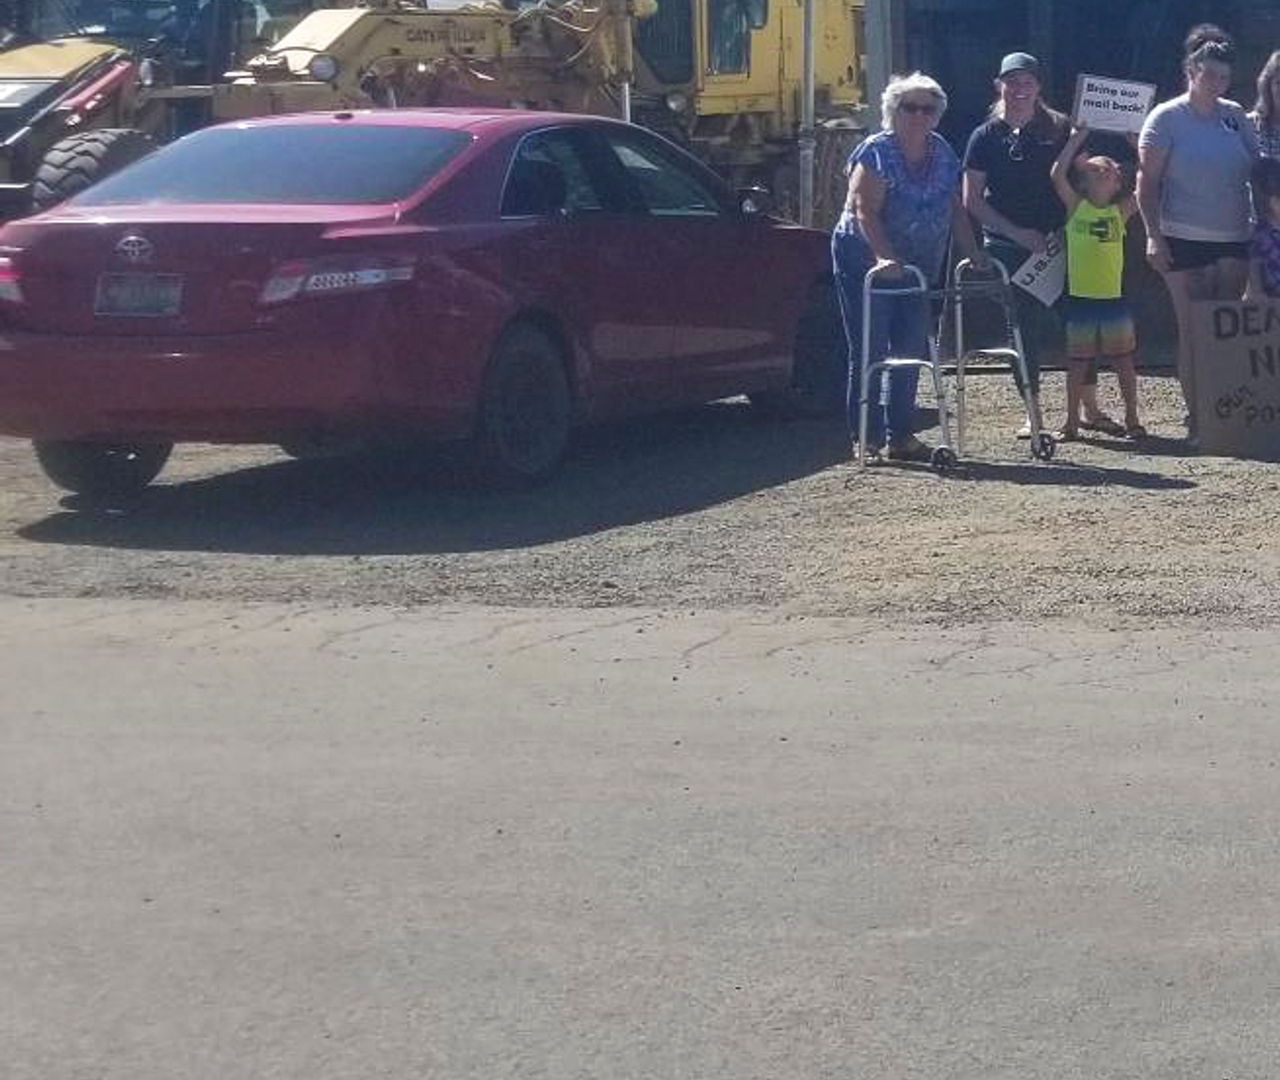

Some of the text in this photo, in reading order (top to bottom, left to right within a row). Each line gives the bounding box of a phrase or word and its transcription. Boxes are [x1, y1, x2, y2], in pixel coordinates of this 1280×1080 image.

[1087, 83, 1139, 98] Bring our
[1083, 99, 1110, 110] mail
